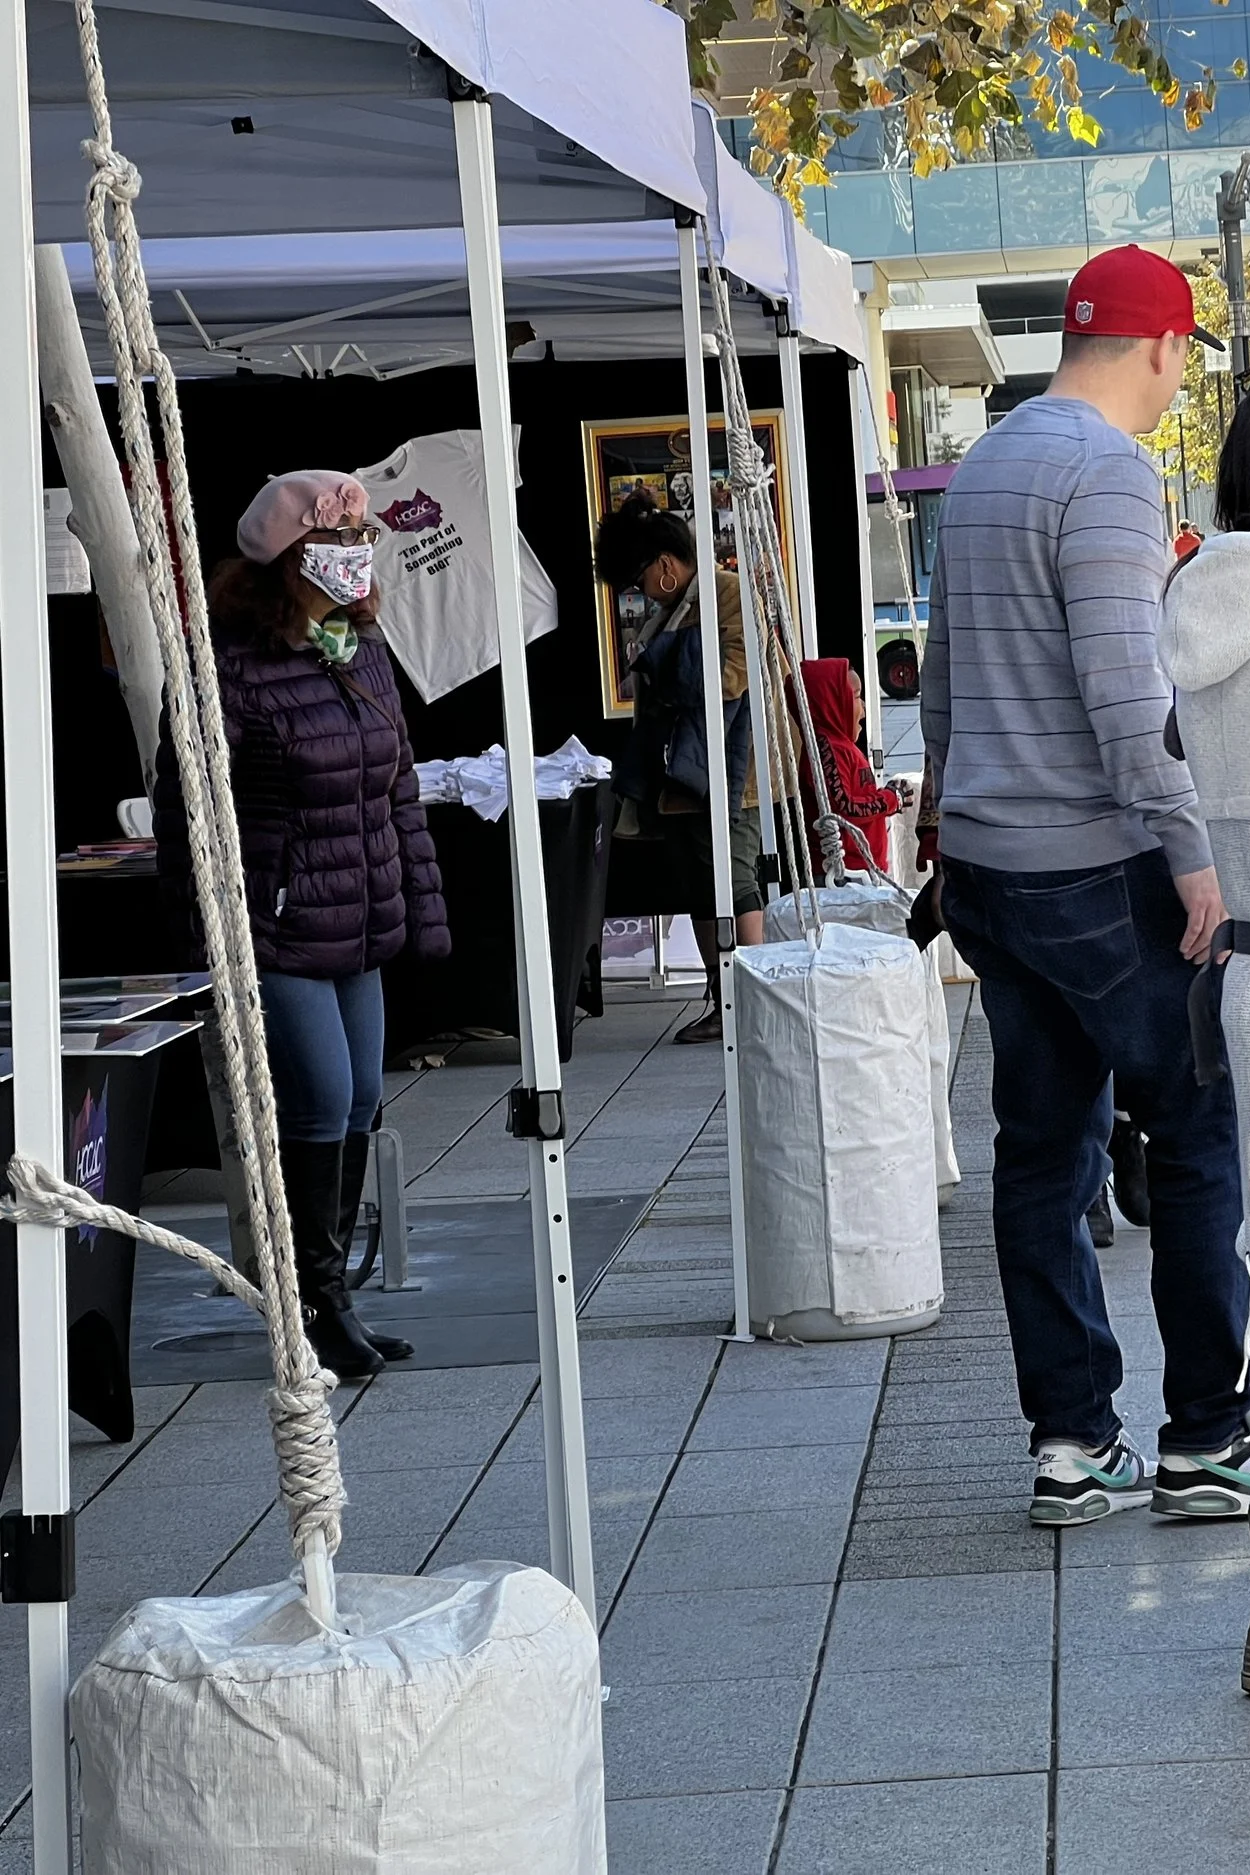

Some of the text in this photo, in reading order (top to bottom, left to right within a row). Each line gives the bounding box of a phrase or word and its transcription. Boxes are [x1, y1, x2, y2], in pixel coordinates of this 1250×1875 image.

[420, 530, 444, 548] Part
[444, 523, 456, 535] of
[405, 536, 463, 572] Something
